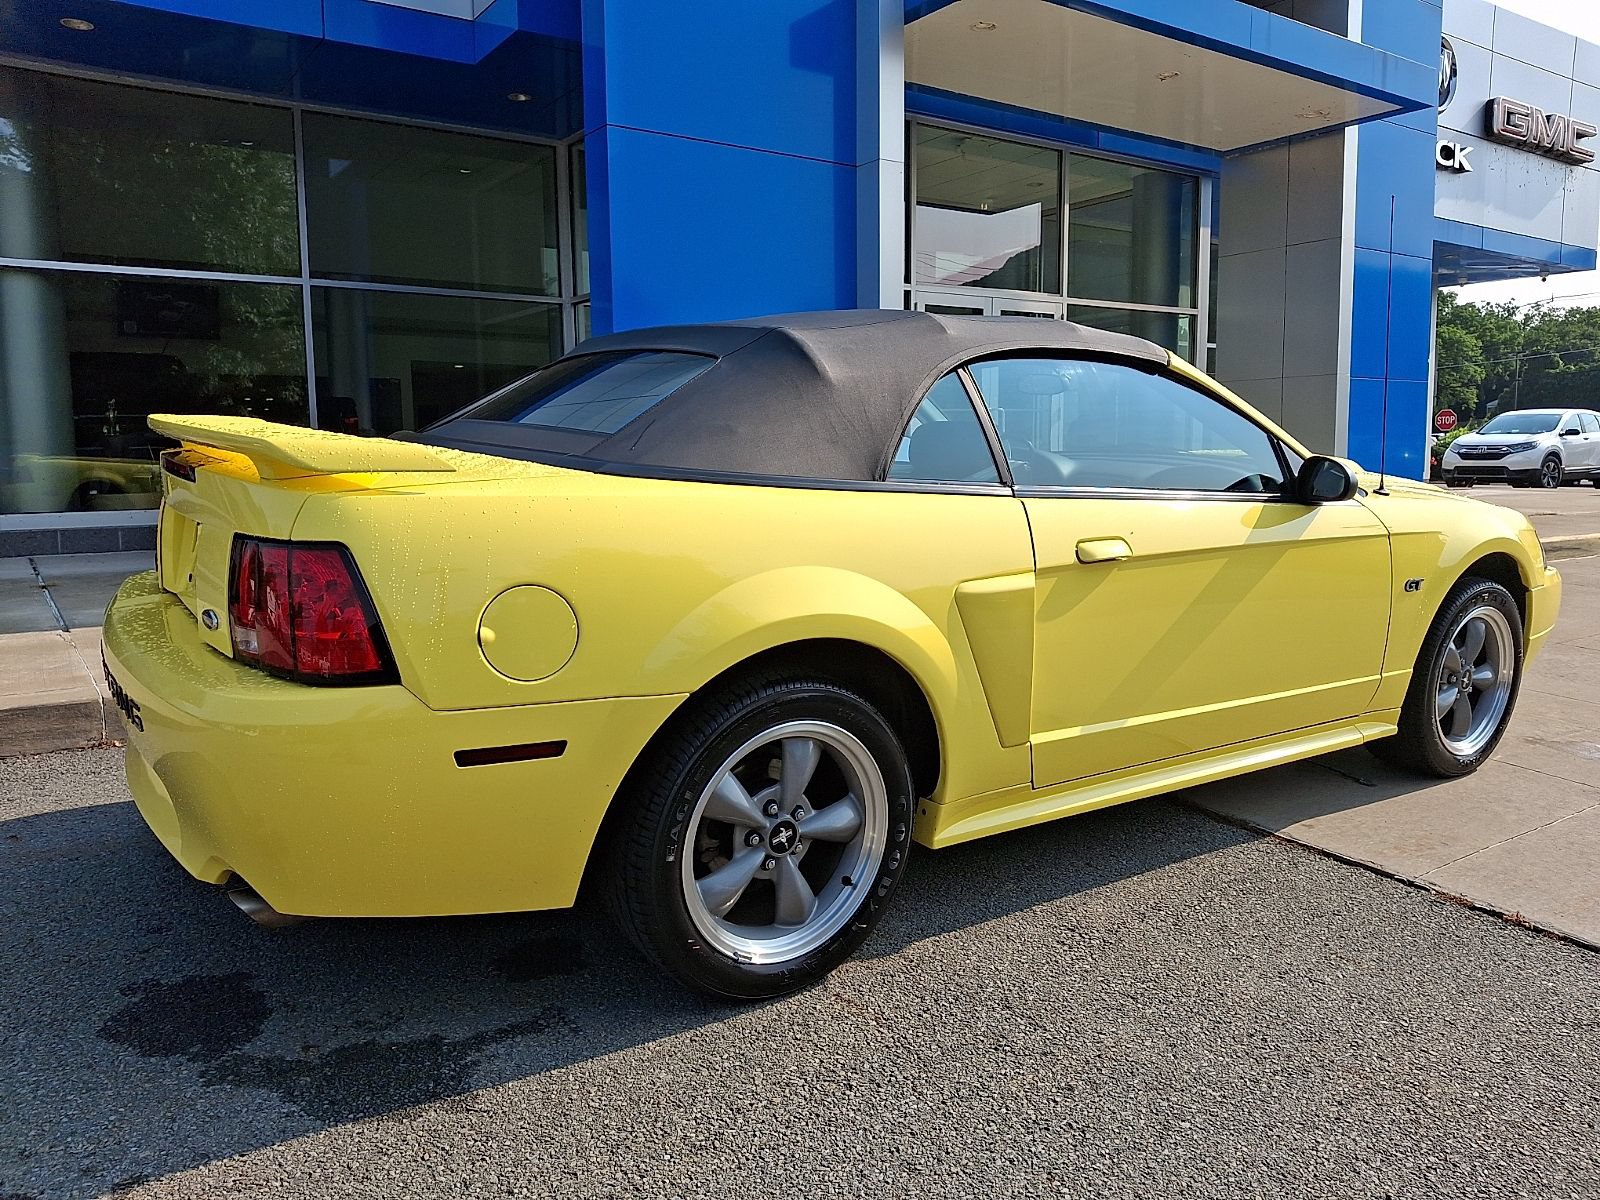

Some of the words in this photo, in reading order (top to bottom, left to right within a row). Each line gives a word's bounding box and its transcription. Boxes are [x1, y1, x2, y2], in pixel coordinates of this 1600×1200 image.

[1489, 97, 1597, 163] GMC
[1437, 416, 1455, 425] STOP
[1404, 578, 1425, 592] GT
